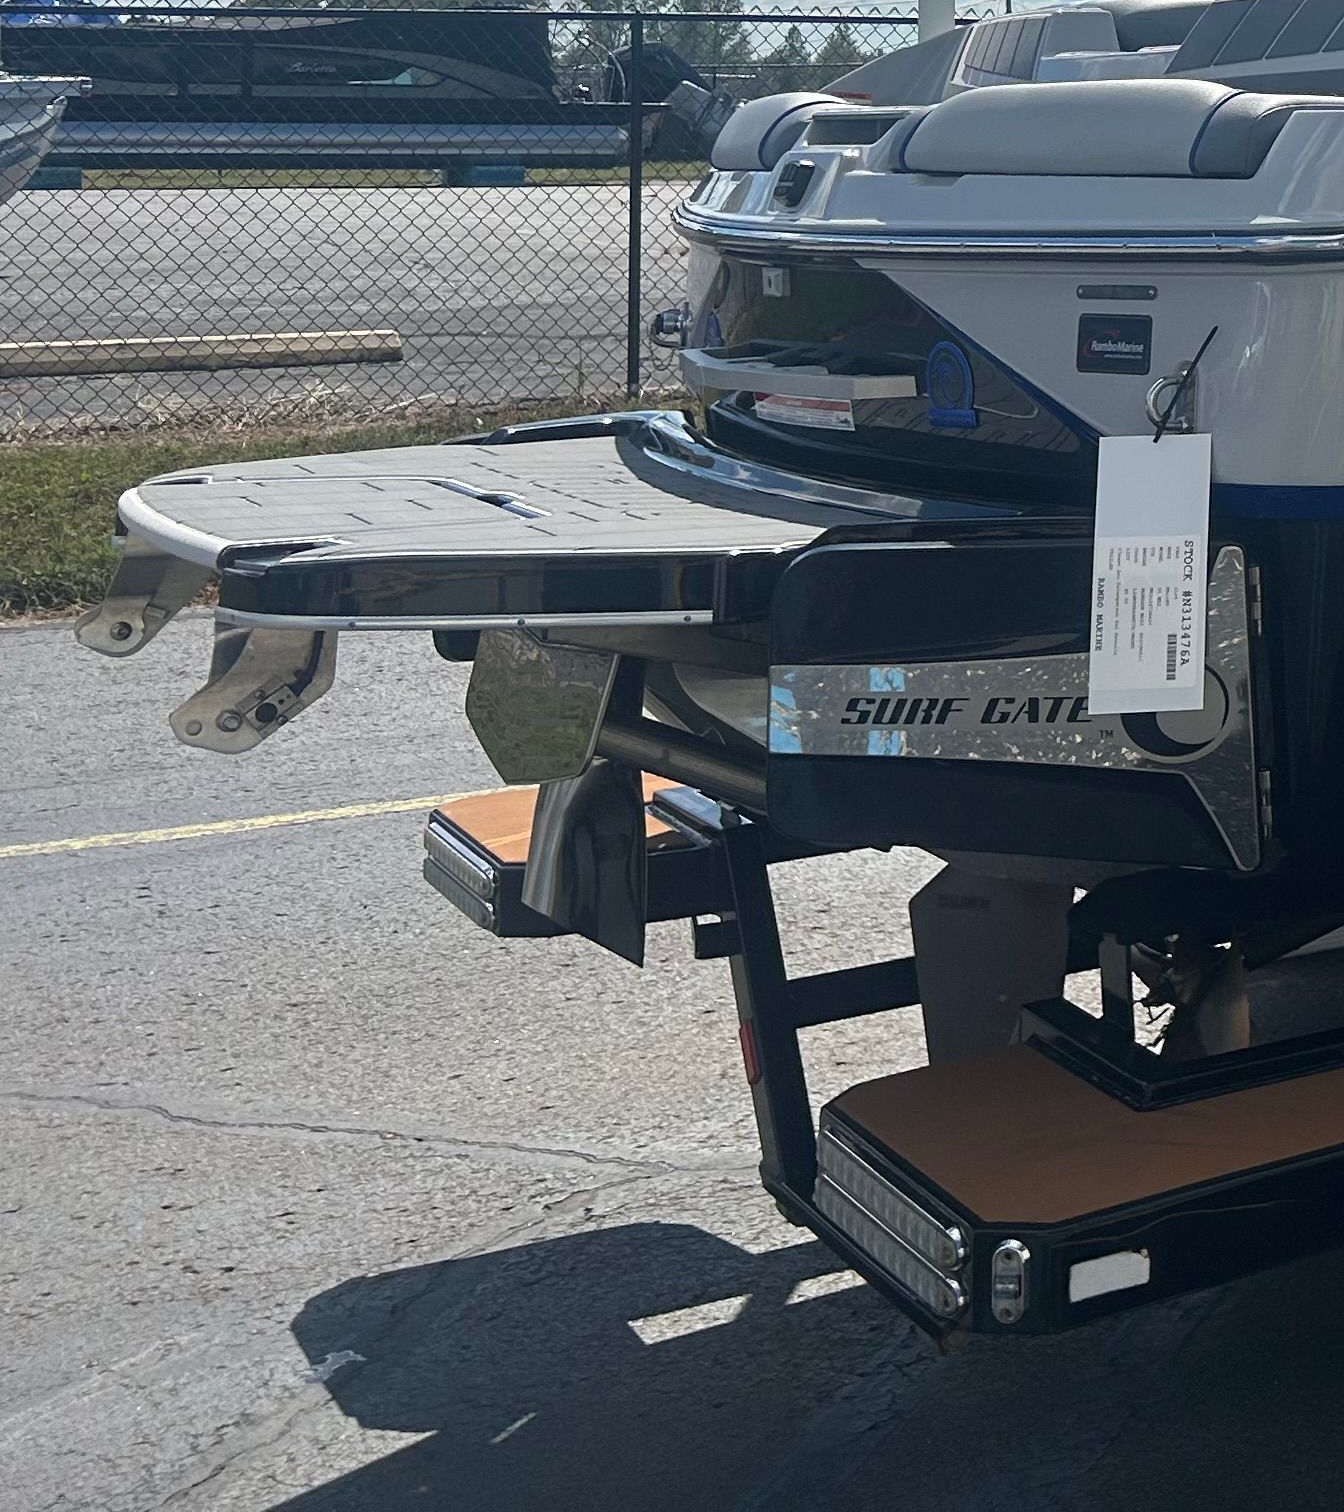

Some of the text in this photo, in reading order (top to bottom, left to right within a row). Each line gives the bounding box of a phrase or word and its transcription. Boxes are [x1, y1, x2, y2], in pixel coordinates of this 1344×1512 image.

[1095, 577, 1105, 651] RAMBO MARINE
[1180, 540, 1194, 666] STOCK #N313476A
[841, 697, 970, 725] SURF
[980, 696, 1092, 725] GATE
